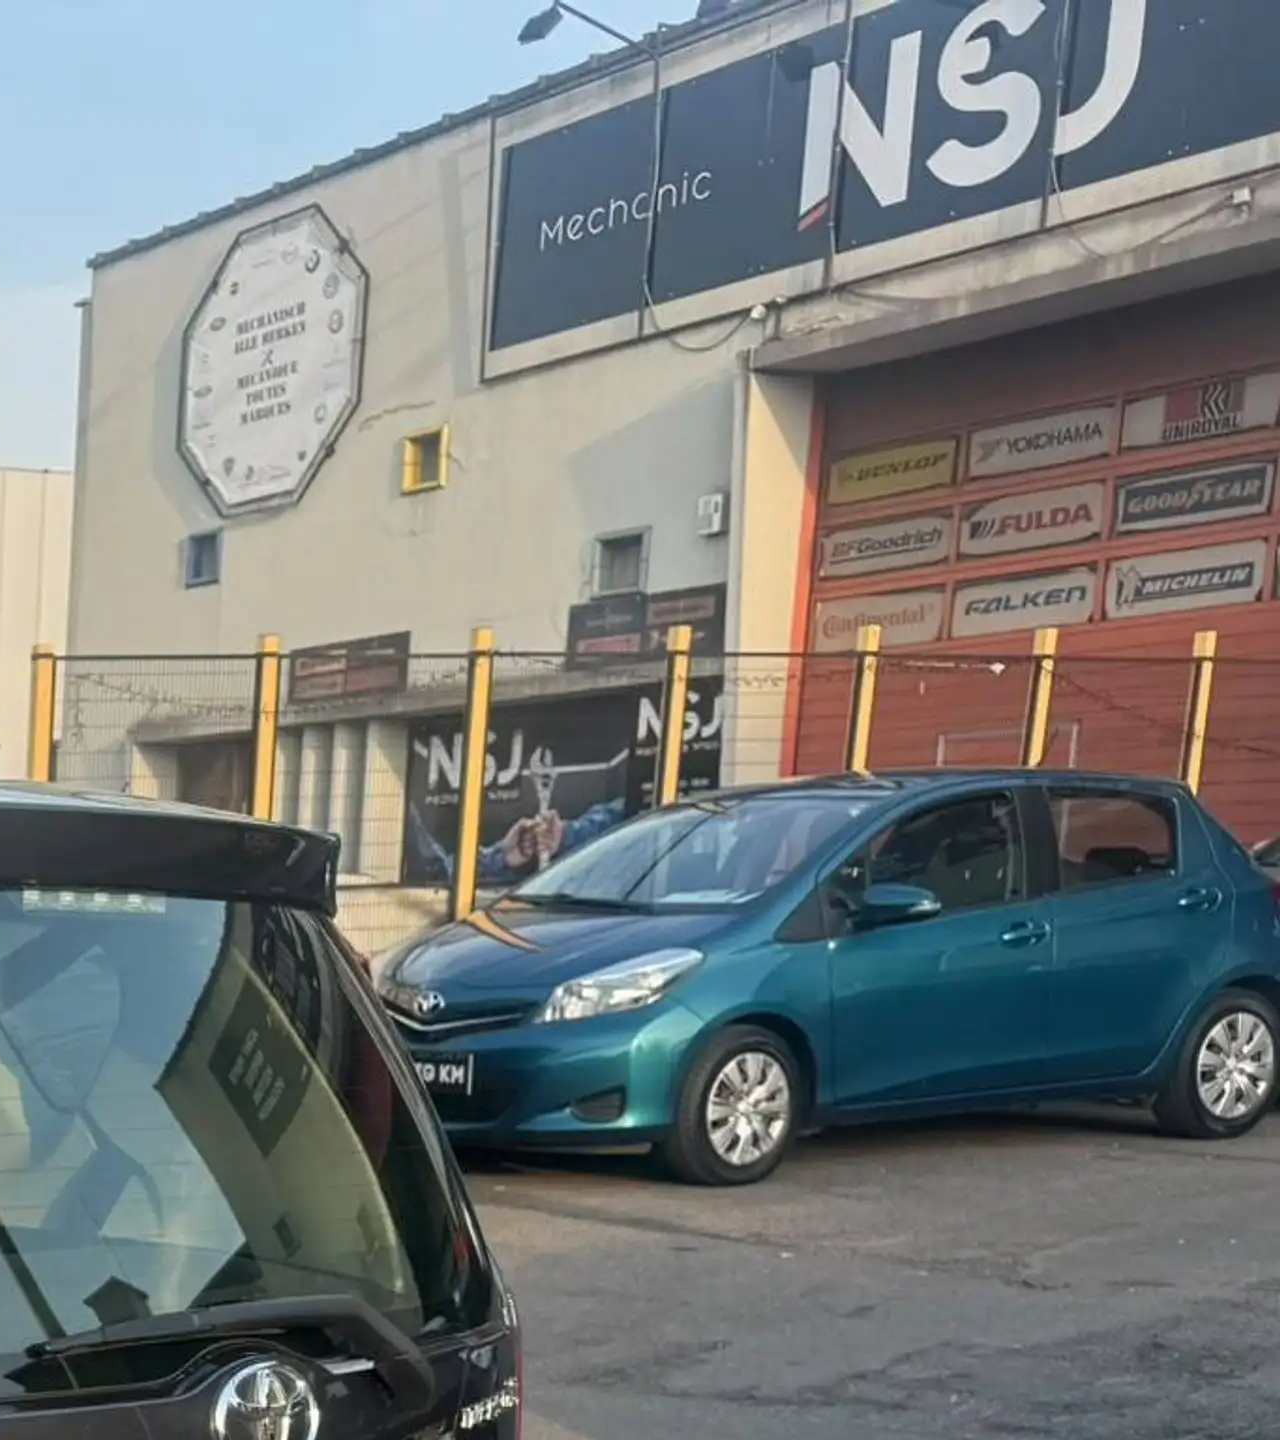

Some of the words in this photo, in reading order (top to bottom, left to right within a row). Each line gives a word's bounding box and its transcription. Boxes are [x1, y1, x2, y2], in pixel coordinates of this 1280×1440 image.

[797, 0, 1146, 228] NSJ
[539, 170, 712, 252] Mechanic
[1005, 420, 1104, 456] YOKOHAMA
[1163, 411, 1241, 442] UNIROYAL
[856, 452, 949, 482] DUNLOP
[1127, 478, 1262, 515] GOODYEAR
[995, 503, 1094, 537] FULDA
[831, 525, 944, 560] BFGoodrich
[1140, 565, 1251, 597] MICHELIN
[964, 585, 1087, 617] FALKEN
